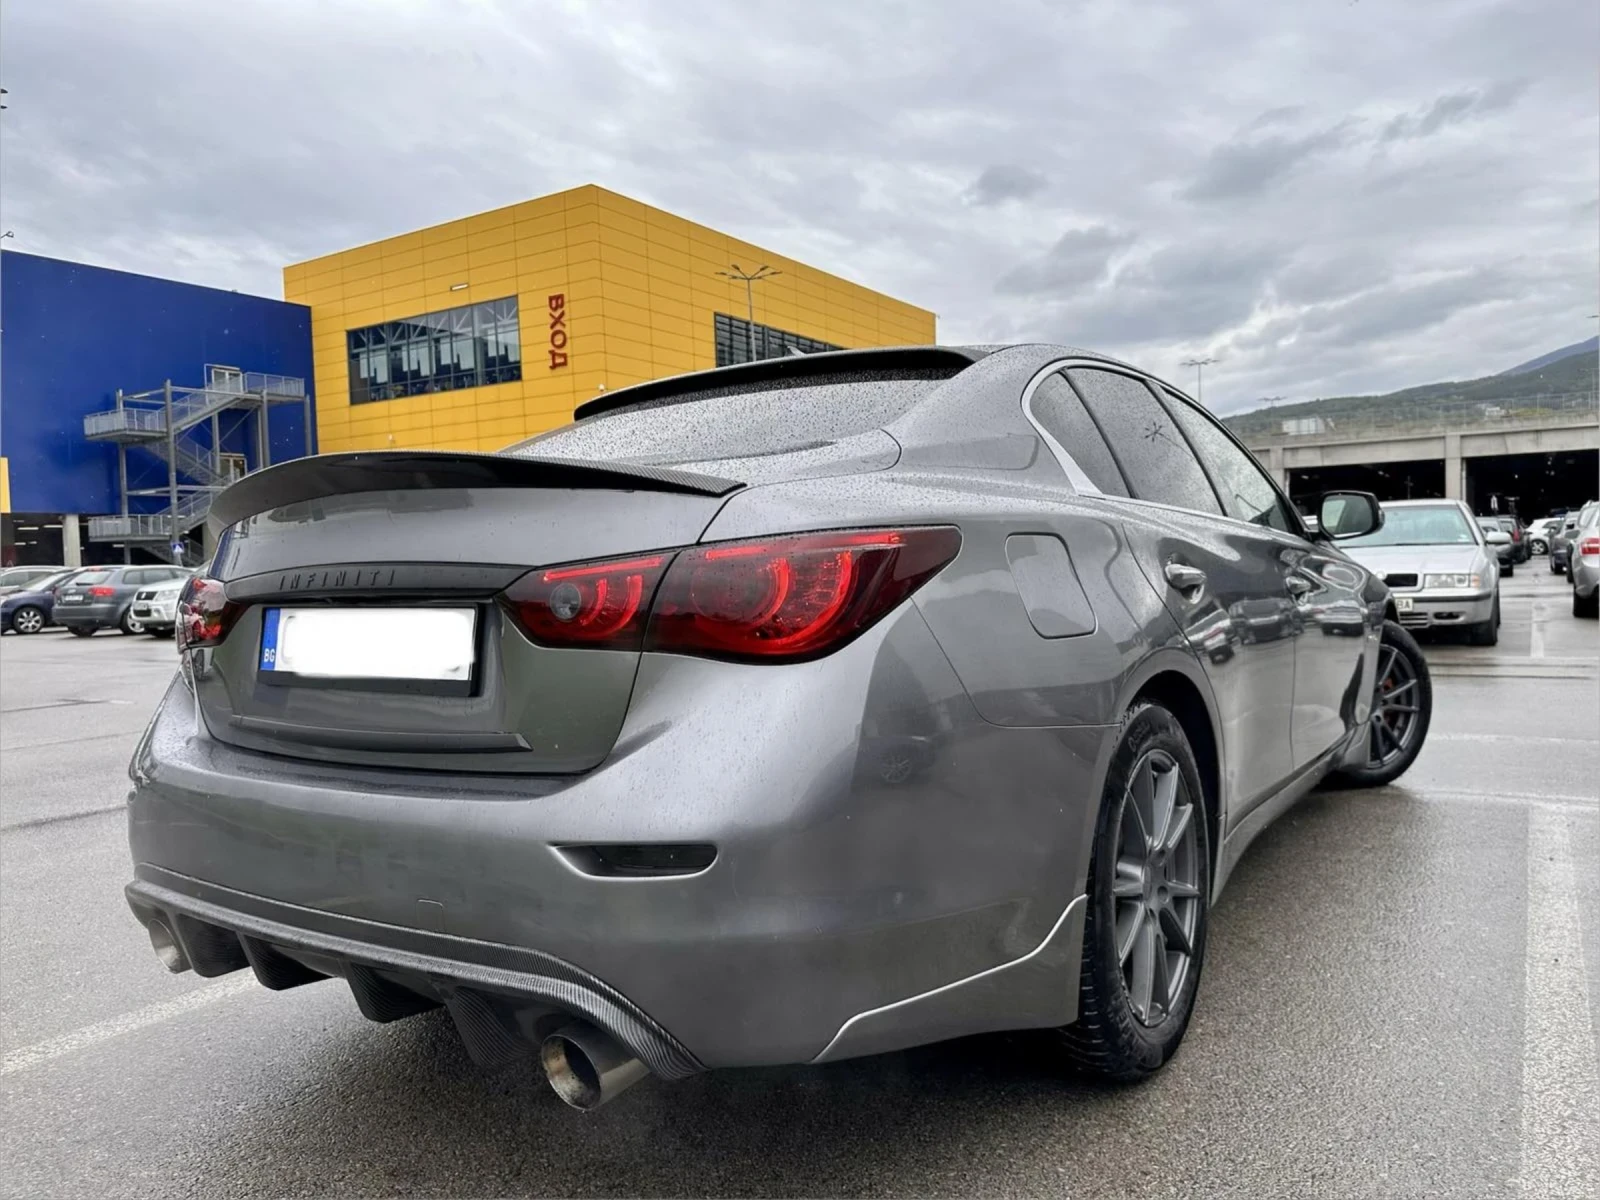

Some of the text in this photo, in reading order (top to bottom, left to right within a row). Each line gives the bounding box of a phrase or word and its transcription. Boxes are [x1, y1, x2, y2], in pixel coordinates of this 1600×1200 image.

[548, 293, 568, 370] ВХОД
[279, 569, 395, 590] INFINITI
[264, 648, 275, 662] BG
